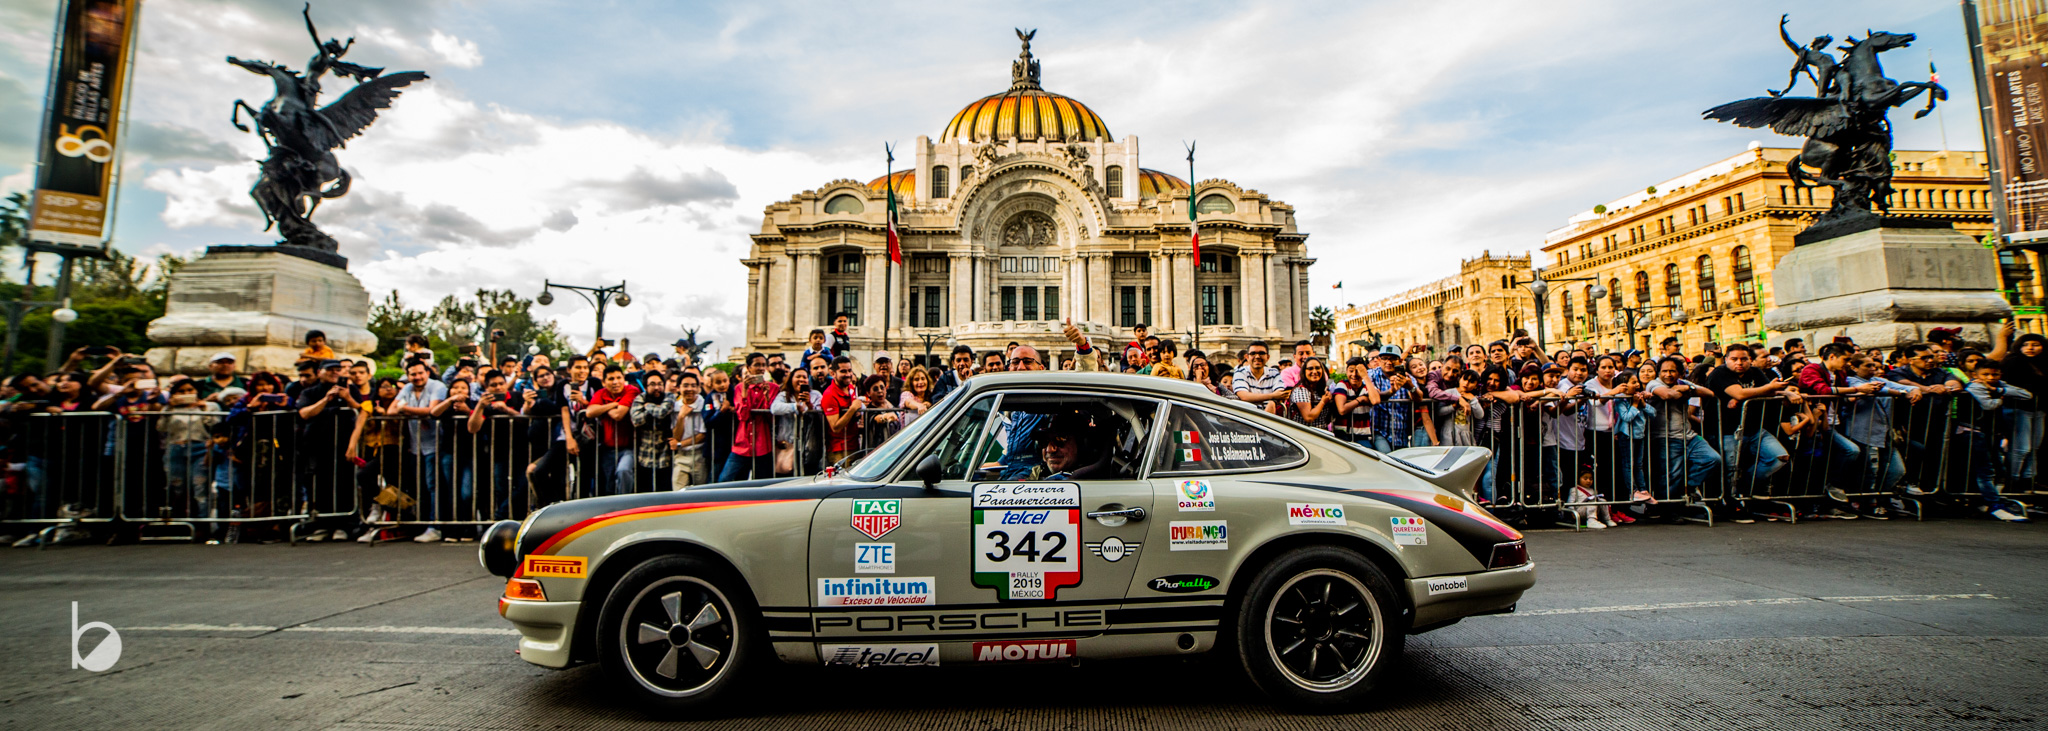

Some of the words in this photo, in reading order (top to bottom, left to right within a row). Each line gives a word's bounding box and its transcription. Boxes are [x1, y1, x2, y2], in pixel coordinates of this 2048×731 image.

[2007, 70, 2024, 95] ARTES
[2010, 95, 2029, 127] BELLAS
[2028, 105, 2046, 125] LAKE
[2015, 133, 2032, 151] UNO
[2019, 157, 2036, 175] UNO
[42, 194, 79, 208] SEP
[1208, 431, 1220, 444] José
[1219, 431, 1230, 444] Luis
[1230, 431, 1256, 444] Salamanca
[1222, 446, 1253, 461] Salamanca
[986, 484, 1007, 494] La
[1012, 484, 1066, 495] Carrera
[856, 501, 897, 513] TAG
[978, 493, 1075, 506] Panamericana
[1001, 510, 1051, 525] telcel
[854, 516, 898, 536] HEUER
[1171, 525, 1227, 540] DURANGO
[985, 530, 1067, 562] 342
[1103, 545, 1123, 553] MINI
[857, 545, 893, 564] ZTE
[529, 559, 582, 573] PIRELLI
[824, 578, 928, 596] infinitum
[1013, 578, 1042, 588] 2019
[1429, 579, 1467, 592] Vontobel
[843, 596, 873, 605] Exceso
[874, 596, 885, 605] de
[887, 595, 927, 605] Velocidad
[1011, 589, 1043, 598] MÉXICO
[815, 609, 1102, 633] PORSCHE
[858, 646, 935, 665] telcel
[978, 642, 1072, 662] MOTUL
